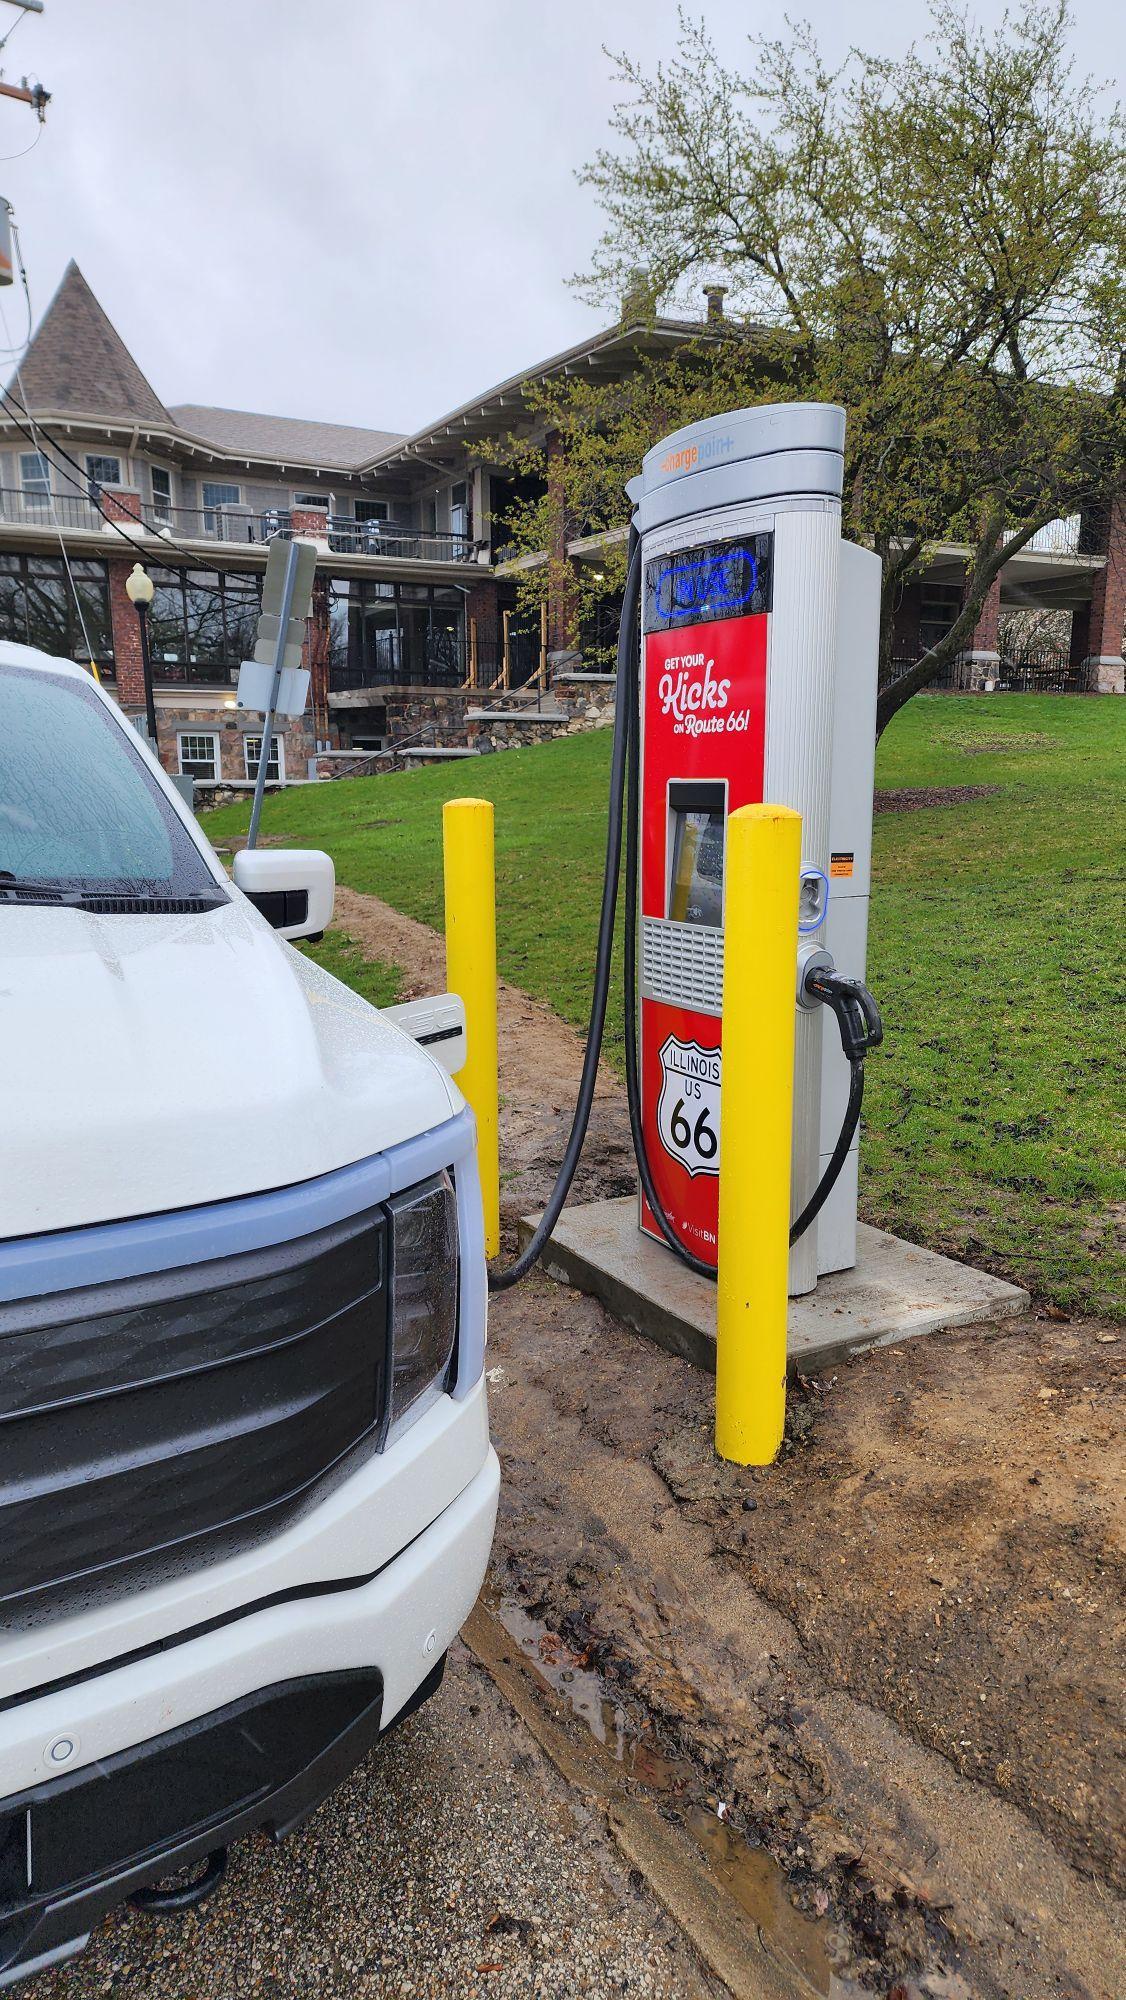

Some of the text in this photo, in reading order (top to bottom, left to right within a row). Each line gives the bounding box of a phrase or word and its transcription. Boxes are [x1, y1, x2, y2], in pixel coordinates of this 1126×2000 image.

[696, 568, 729, 600] USE
[664, 653, 705, 671] GET YOUR
[658, 659, 731, 721] Kicks
[673, 709, 751, 738] ON Route 66!
[669, 1049, 720, 1080] ILLINOIS
[684, 1079, 702, 1100] US
[670, 1098, 718, 1160] 66
